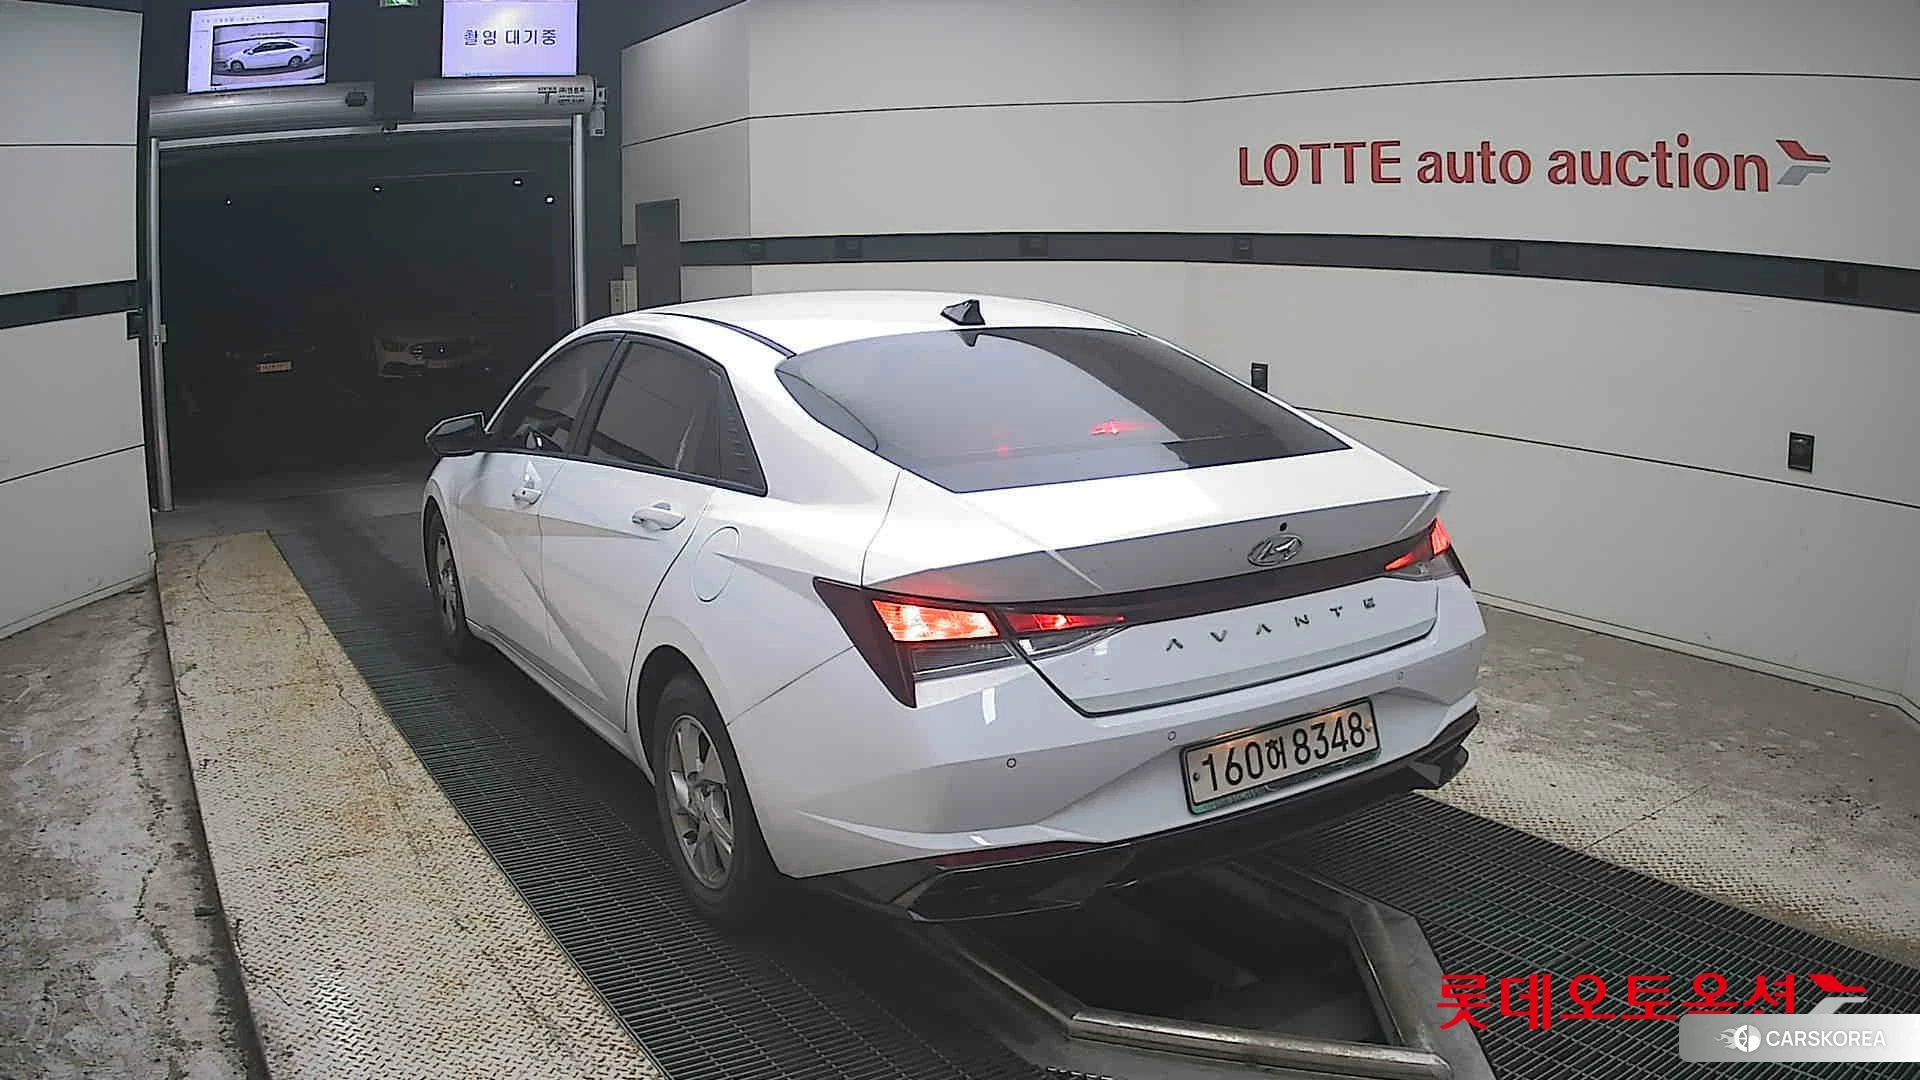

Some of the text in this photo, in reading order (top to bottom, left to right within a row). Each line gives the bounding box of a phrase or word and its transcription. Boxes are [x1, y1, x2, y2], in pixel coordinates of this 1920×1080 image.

[505, 29, 557, 46] 대기중
[1239, 133, 1769, 192] LOTTE auto auction
[1165, 597, 1377, 651] AVANTE
[1202, 711, 1366, 791] 160허 8348
